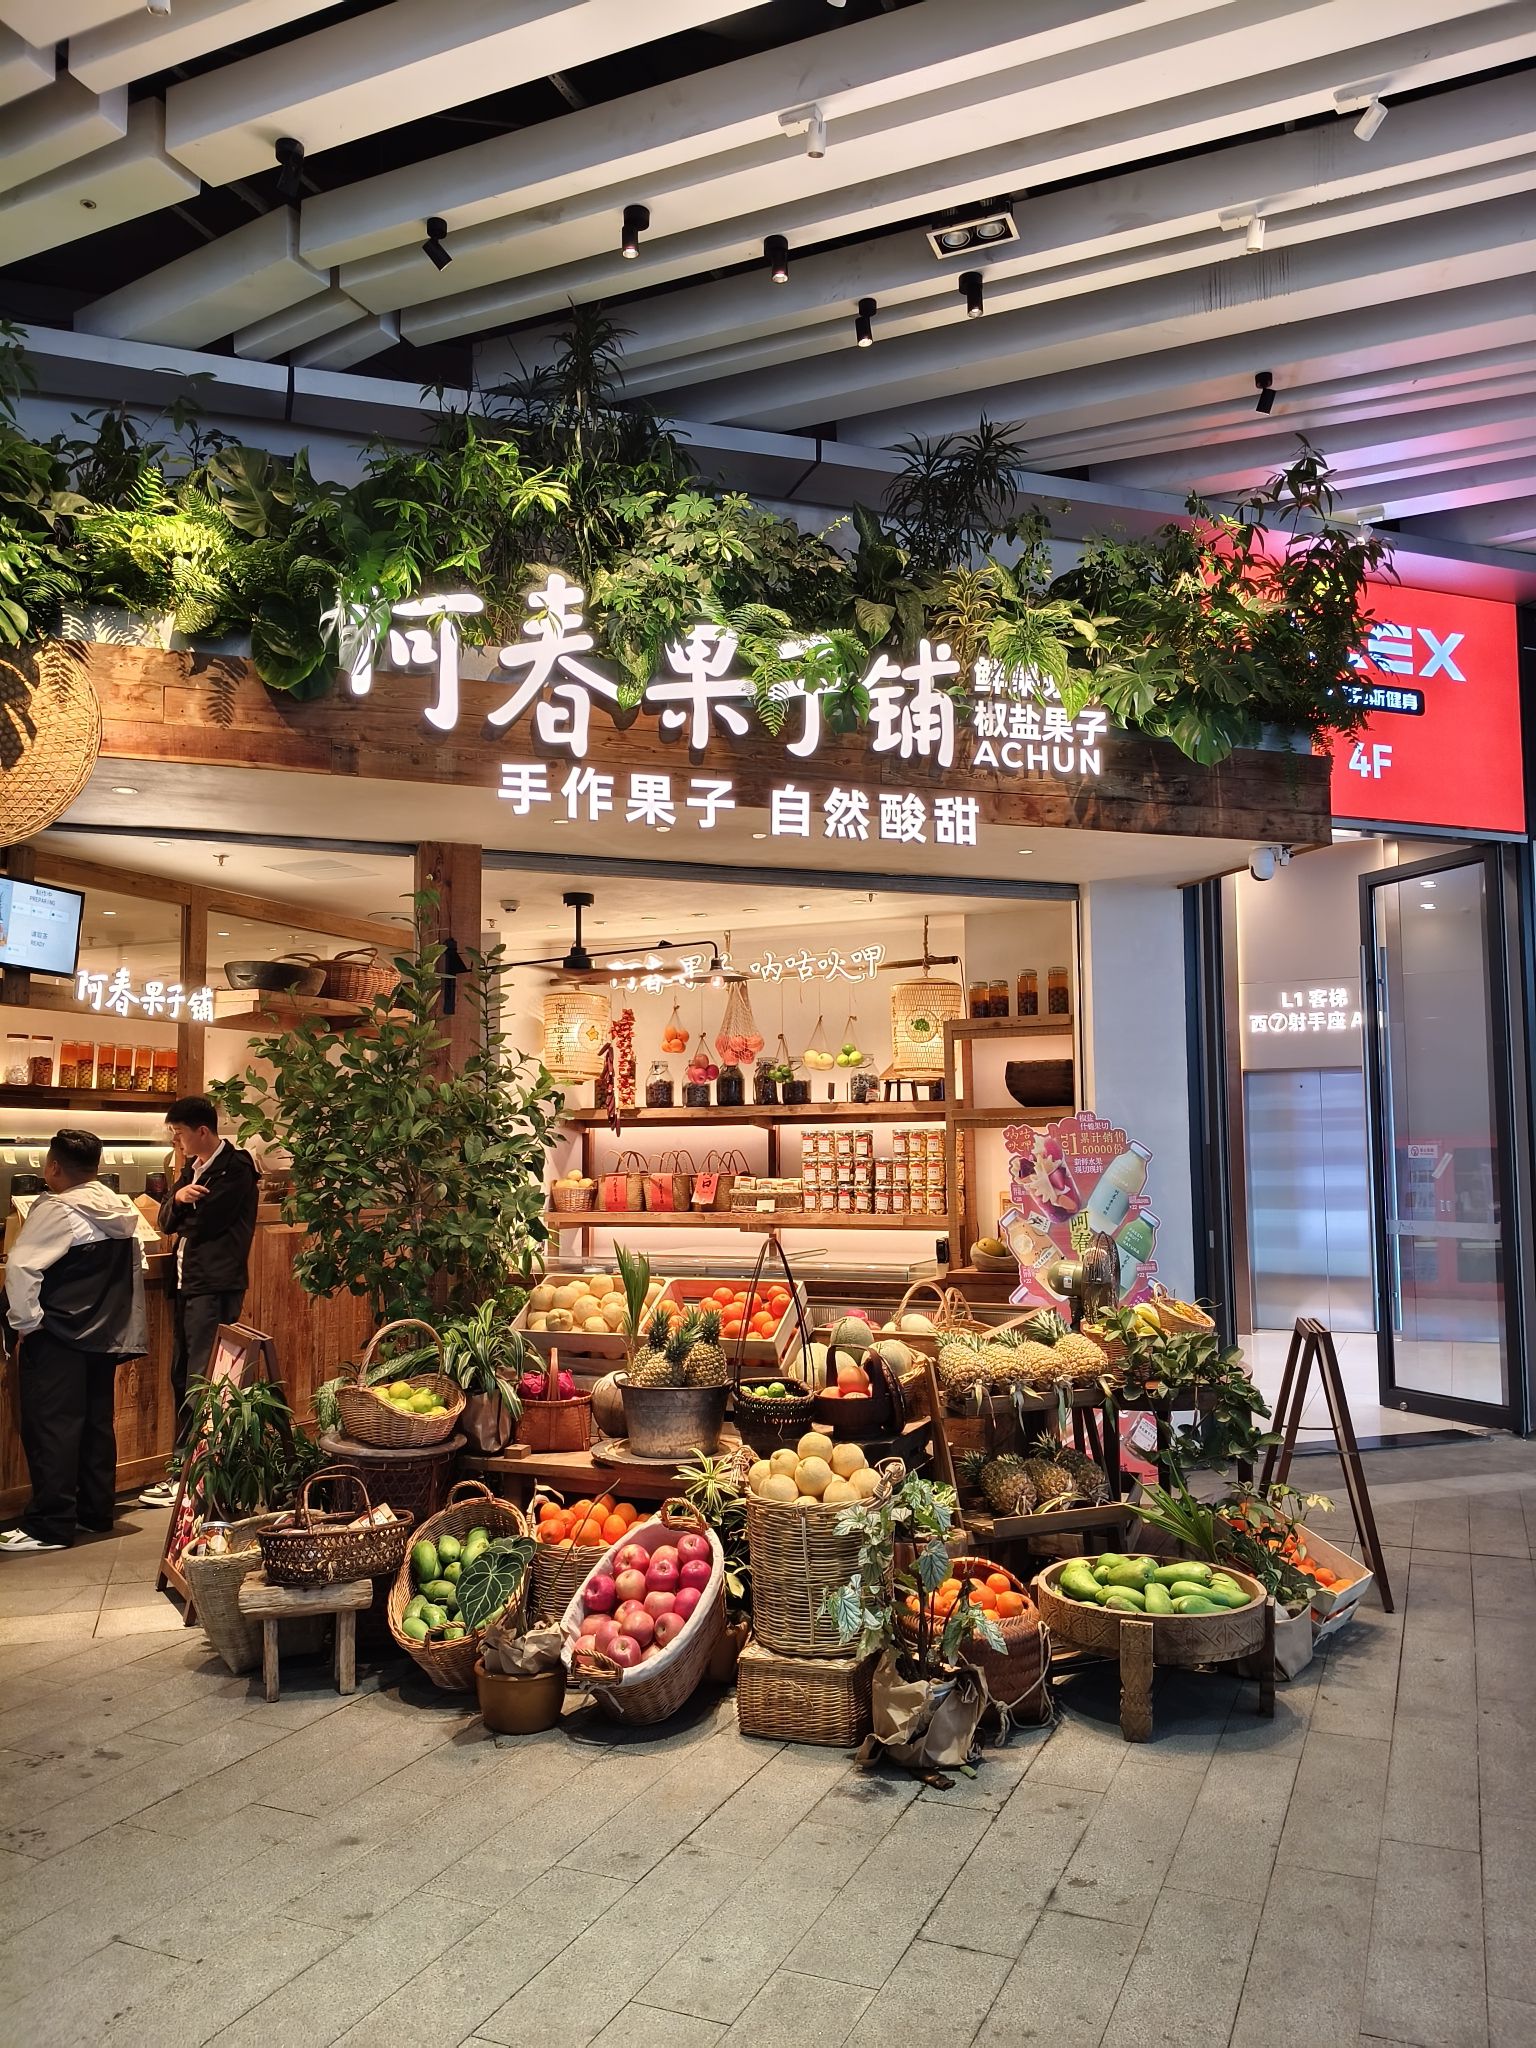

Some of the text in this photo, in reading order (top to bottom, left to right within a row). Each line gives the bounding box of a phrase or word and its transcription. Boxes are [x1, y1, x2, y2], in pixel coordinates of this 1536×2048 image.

[973, 699, 1108, 747] 椒盐果子
[973, 740, 1101, 776] ACHUN
[1348, 742, 1393, 779] 4F
[498, 763, 980, 847] 手作果子 自然酸甜
[77, 967, 214, 1023] 阿春果子铺
[1281, 987, 1349, 1009] L1 客梯
[1071, 1210, 1091, 1262] 阿春
